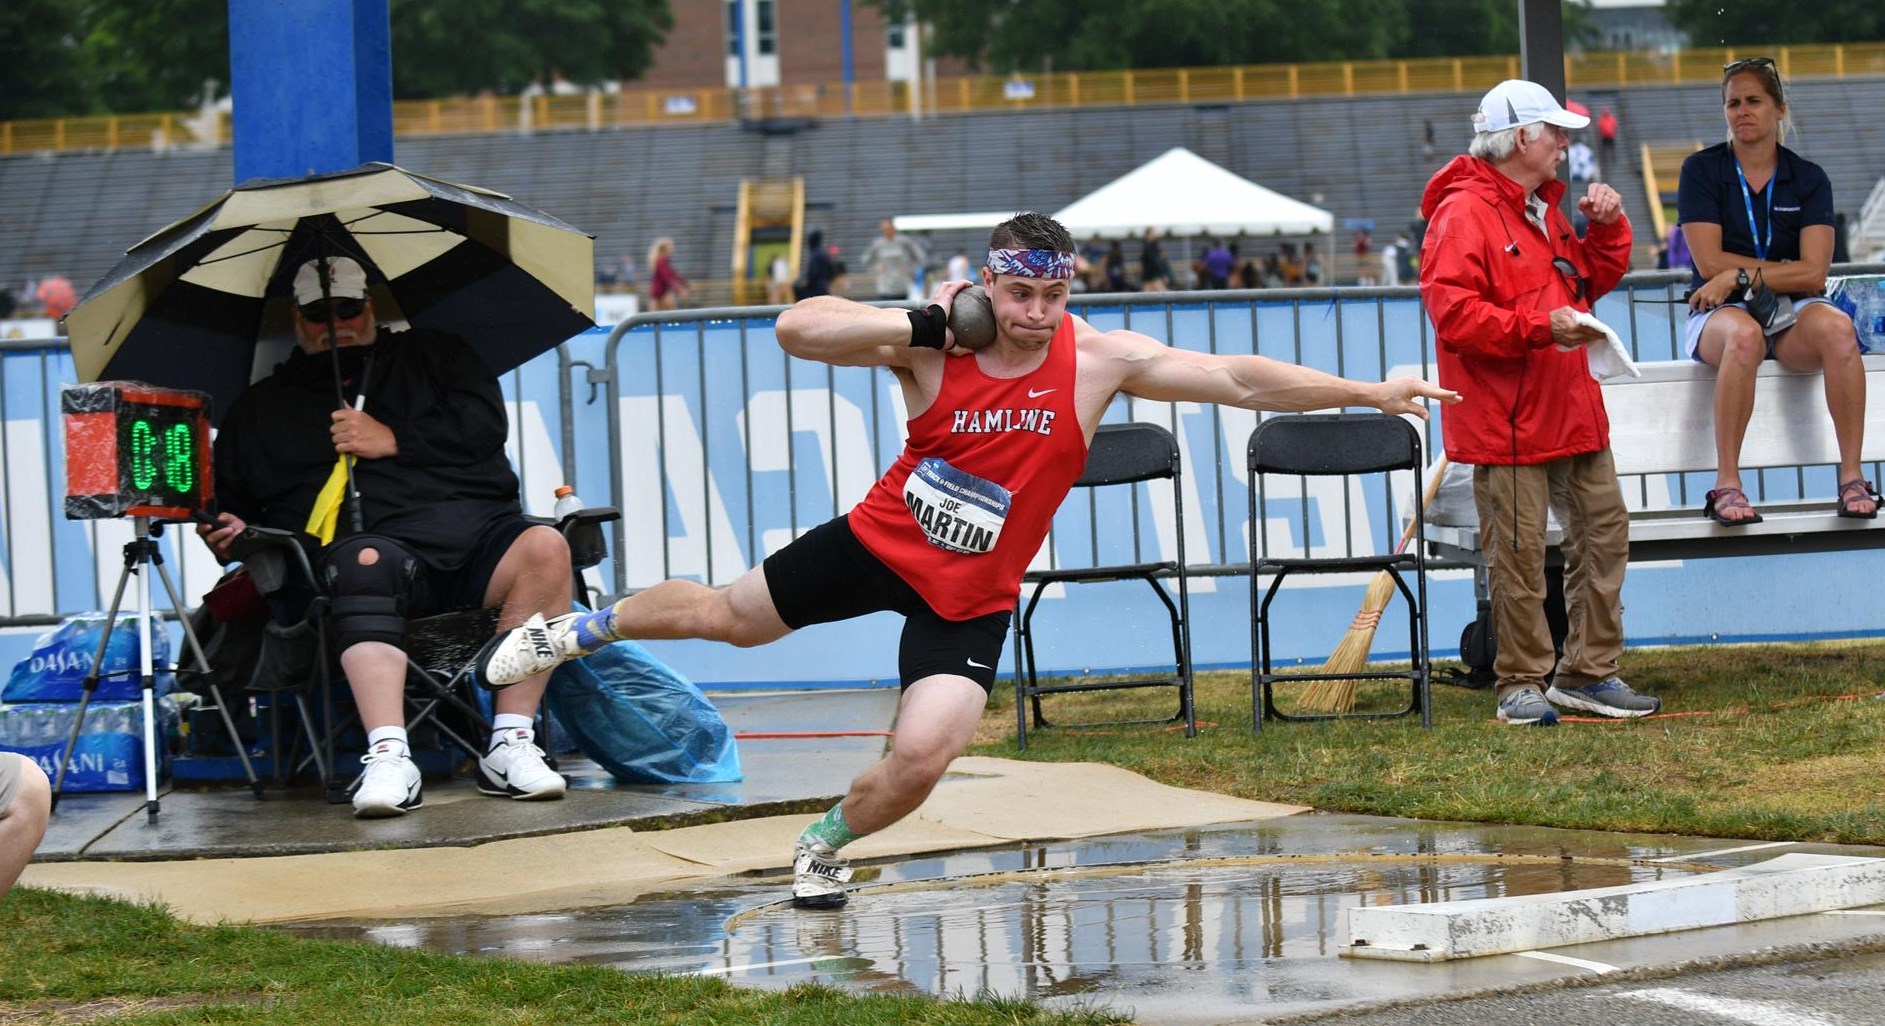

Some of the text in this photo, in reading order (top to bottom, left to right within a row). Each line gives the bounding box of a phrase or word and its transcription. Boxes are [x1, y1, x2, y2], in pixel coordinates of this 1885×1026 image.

[950, 408, 1056, 436] HAMLINE
[939, 497, 962, 514] JOE
[943, 480, 960, 493] FIELD
[959, 486, 1006, 512] CHAMPIONSHIPS
[906, 490, 994, 552] MARTIN
[527, 627, 556, 659] NIKE
[806, 859, 843, 879] NIKE
